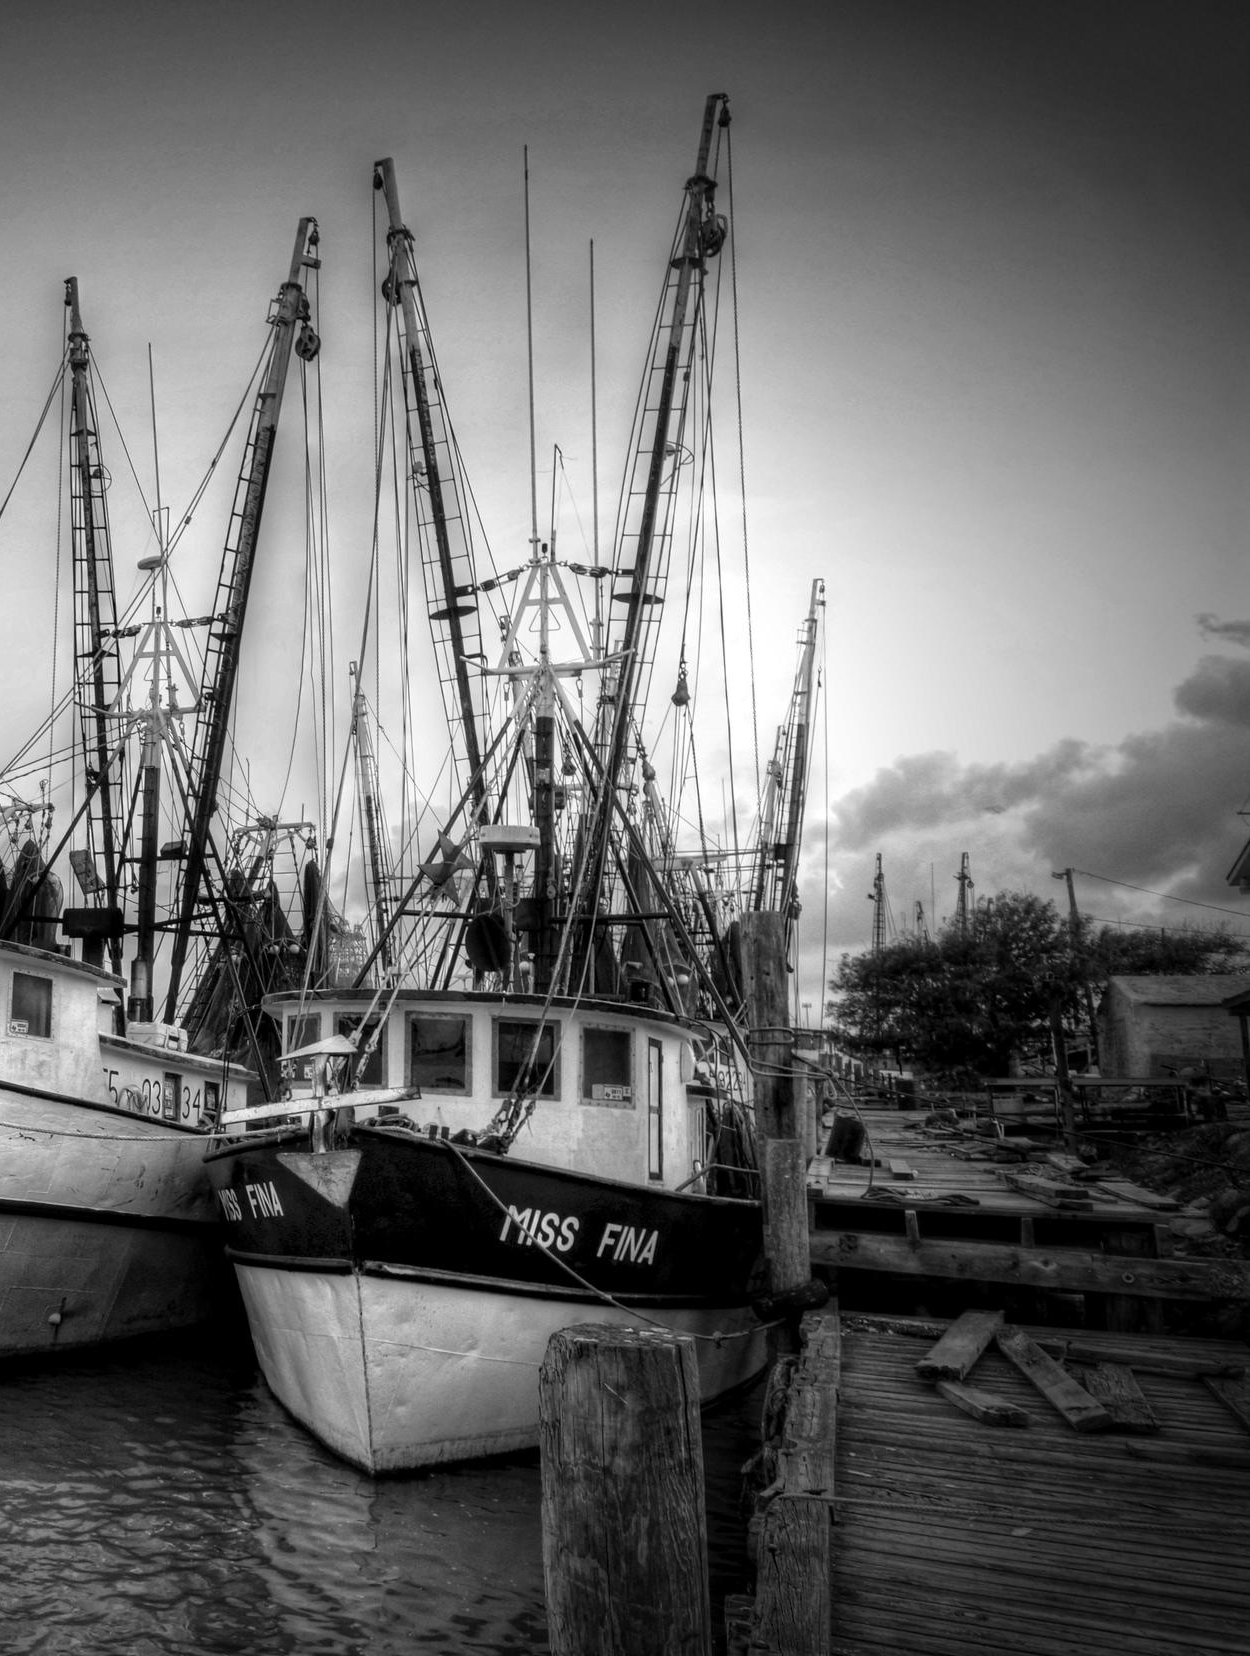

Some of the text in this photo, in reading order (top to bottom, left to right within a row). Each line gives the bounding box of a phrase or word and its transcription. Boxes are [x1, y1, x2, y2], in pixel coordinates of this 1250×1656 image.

[245, 1180, 285, 1219] FINA
[499, 1204, 659, 1265] MISS FINA
